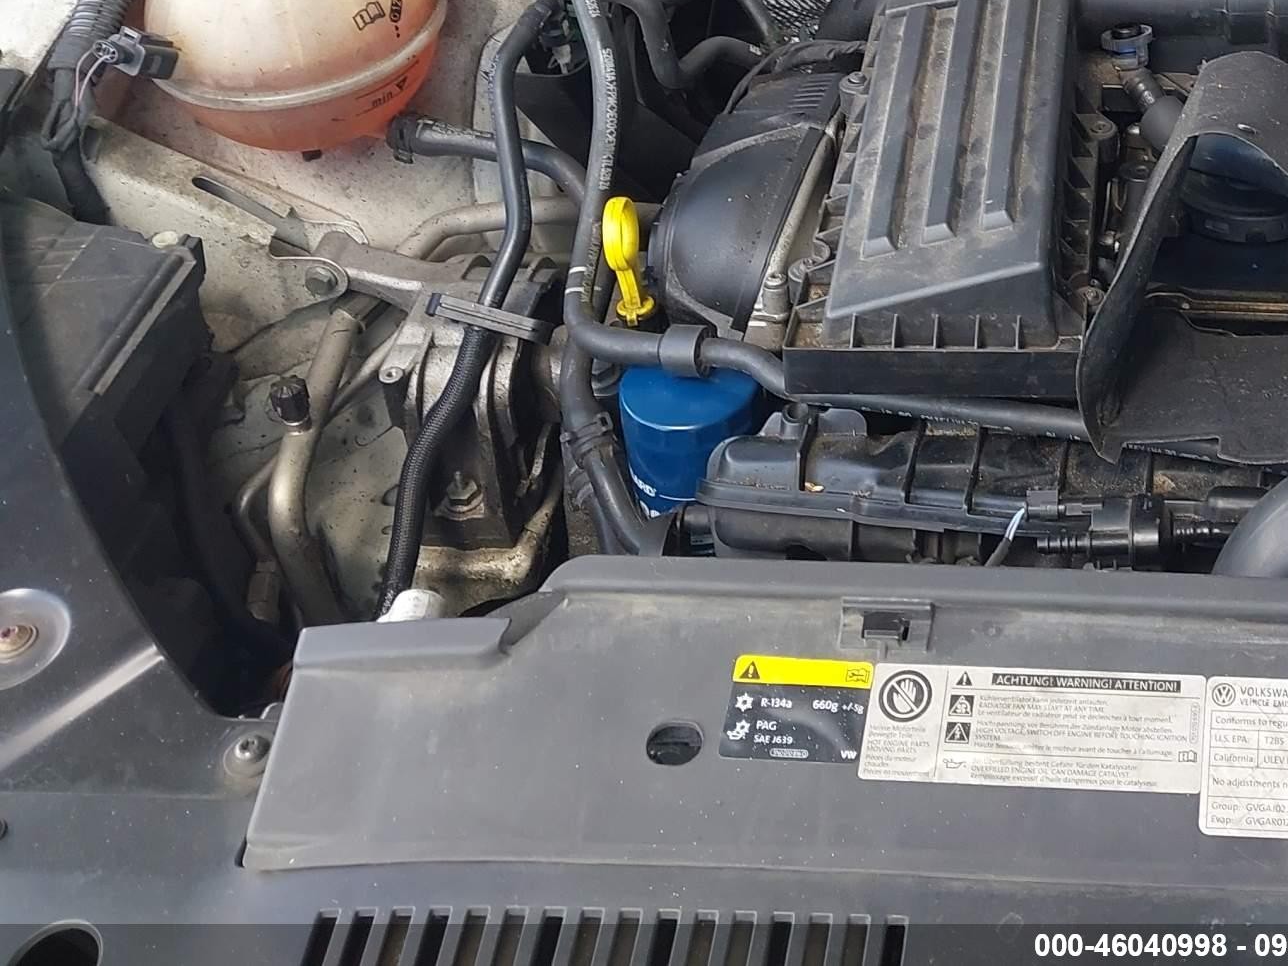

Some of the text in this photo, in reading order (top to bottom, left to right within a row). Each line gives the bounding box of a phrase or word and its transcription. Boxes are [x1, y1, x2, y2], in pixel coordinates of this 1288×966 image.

[372, 91, 393, 108] min
[997, 675, 1178, 692] ACHTUNG! WARNING! ATTENTION!
[761, 697, 792, 708] R-134a
[812, 699, 838, 713] 660g
[1240, 698, 1270, 707] VEHICLE
[756, 720, 777, 731] PAG
[1215, 716, 1257, 725] Conforms
[1258, 718, 1268, 726] to
[753, 735, 793, 745] SAE J639
[840, 750, 858, 760] VW
[1212, 777, 1224, 786] No
[1226, 777, 1280, 789] adjustments
